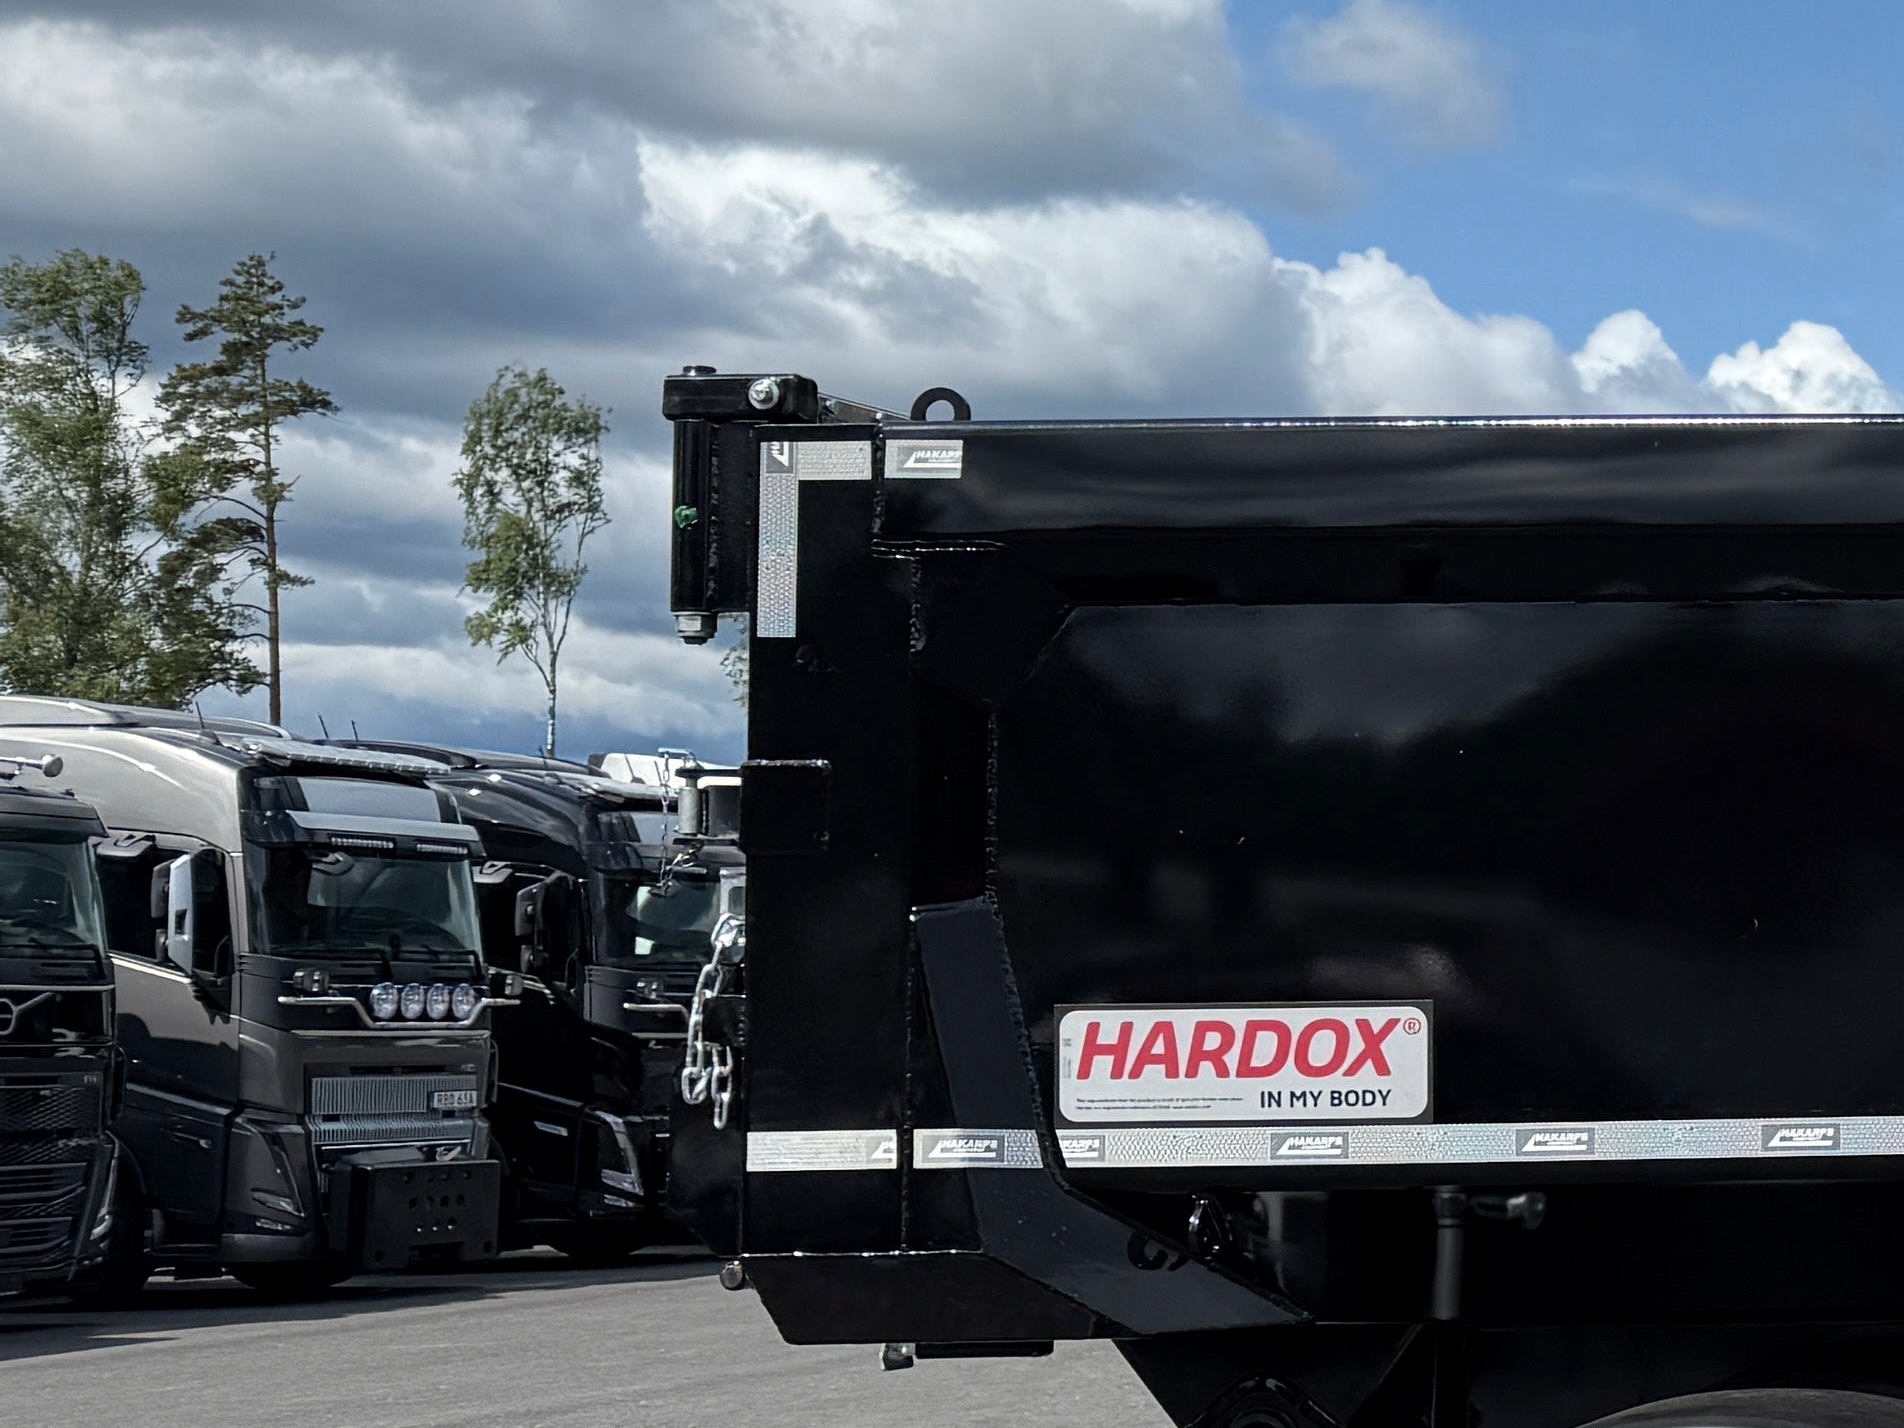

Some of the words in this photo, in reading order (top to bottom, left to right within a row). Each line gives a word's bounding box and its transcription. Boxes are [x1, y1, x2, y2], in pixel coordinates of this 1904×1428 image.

[1260, 1090, 1281, 1108] IN
[1289, 1089, 1323, 1108] MY
[1330, 1089, 1392, 1107] BODY
